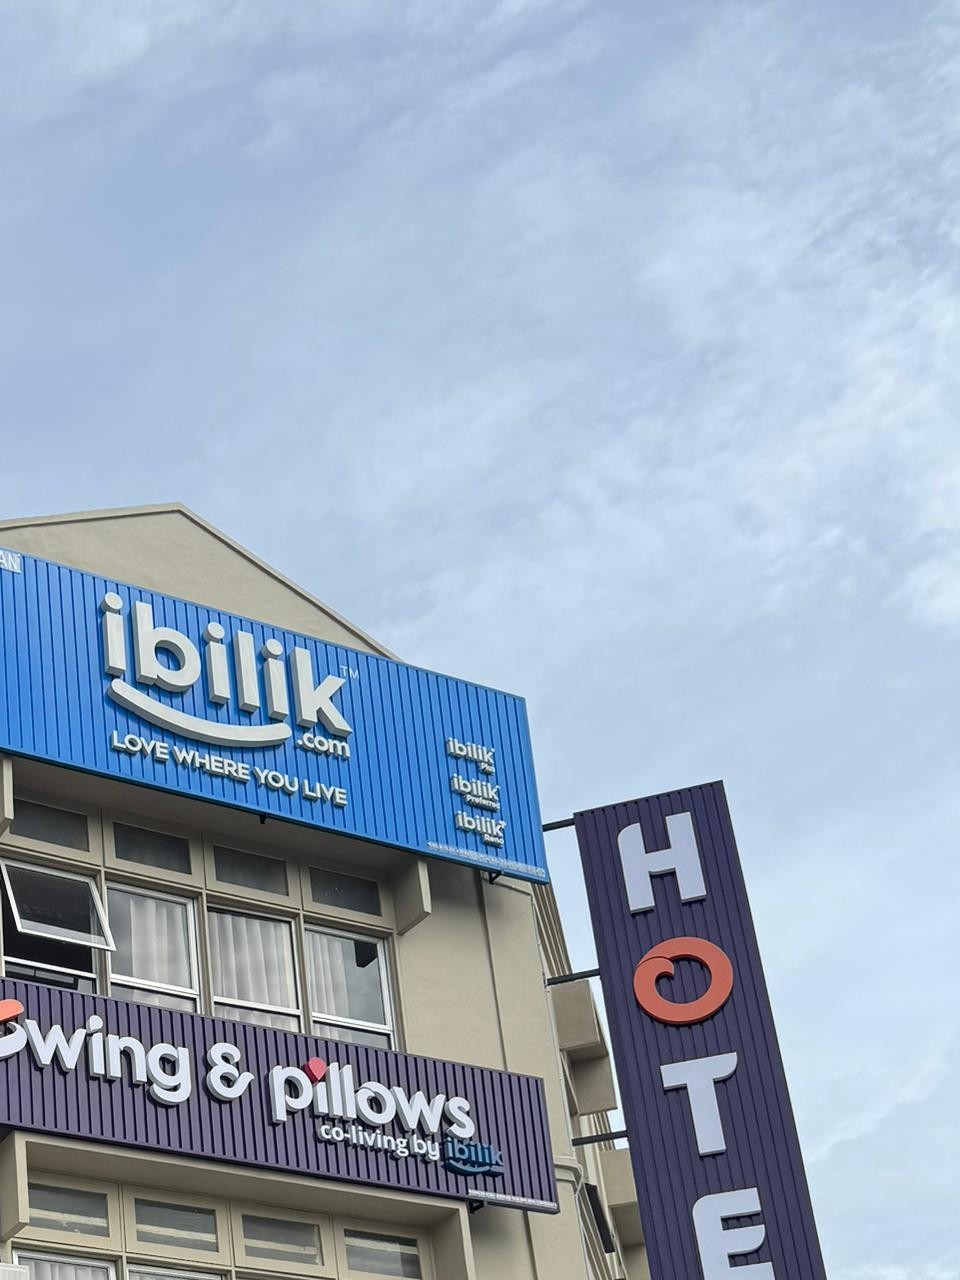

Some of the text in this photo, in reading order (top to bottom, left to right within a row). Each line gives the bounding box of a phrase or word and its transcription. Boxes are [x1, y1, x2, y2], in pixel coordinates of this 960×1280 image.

[101, 592, 353, 738] ibilik
[297, 732, 351, 759] .com
[446, 737, 494, 765] ibilik
[111, 730, 348, 807] LOVE WHERE YOU LIVE
[451, 773, 499, 801] ibilik
[455, 811, 504, 837] ibilik
[206, 1042, 255, 1102] &
[269, 1056, 476, 1139] pillows
[318, 1124, 505, 1168] co-living by ibilik
